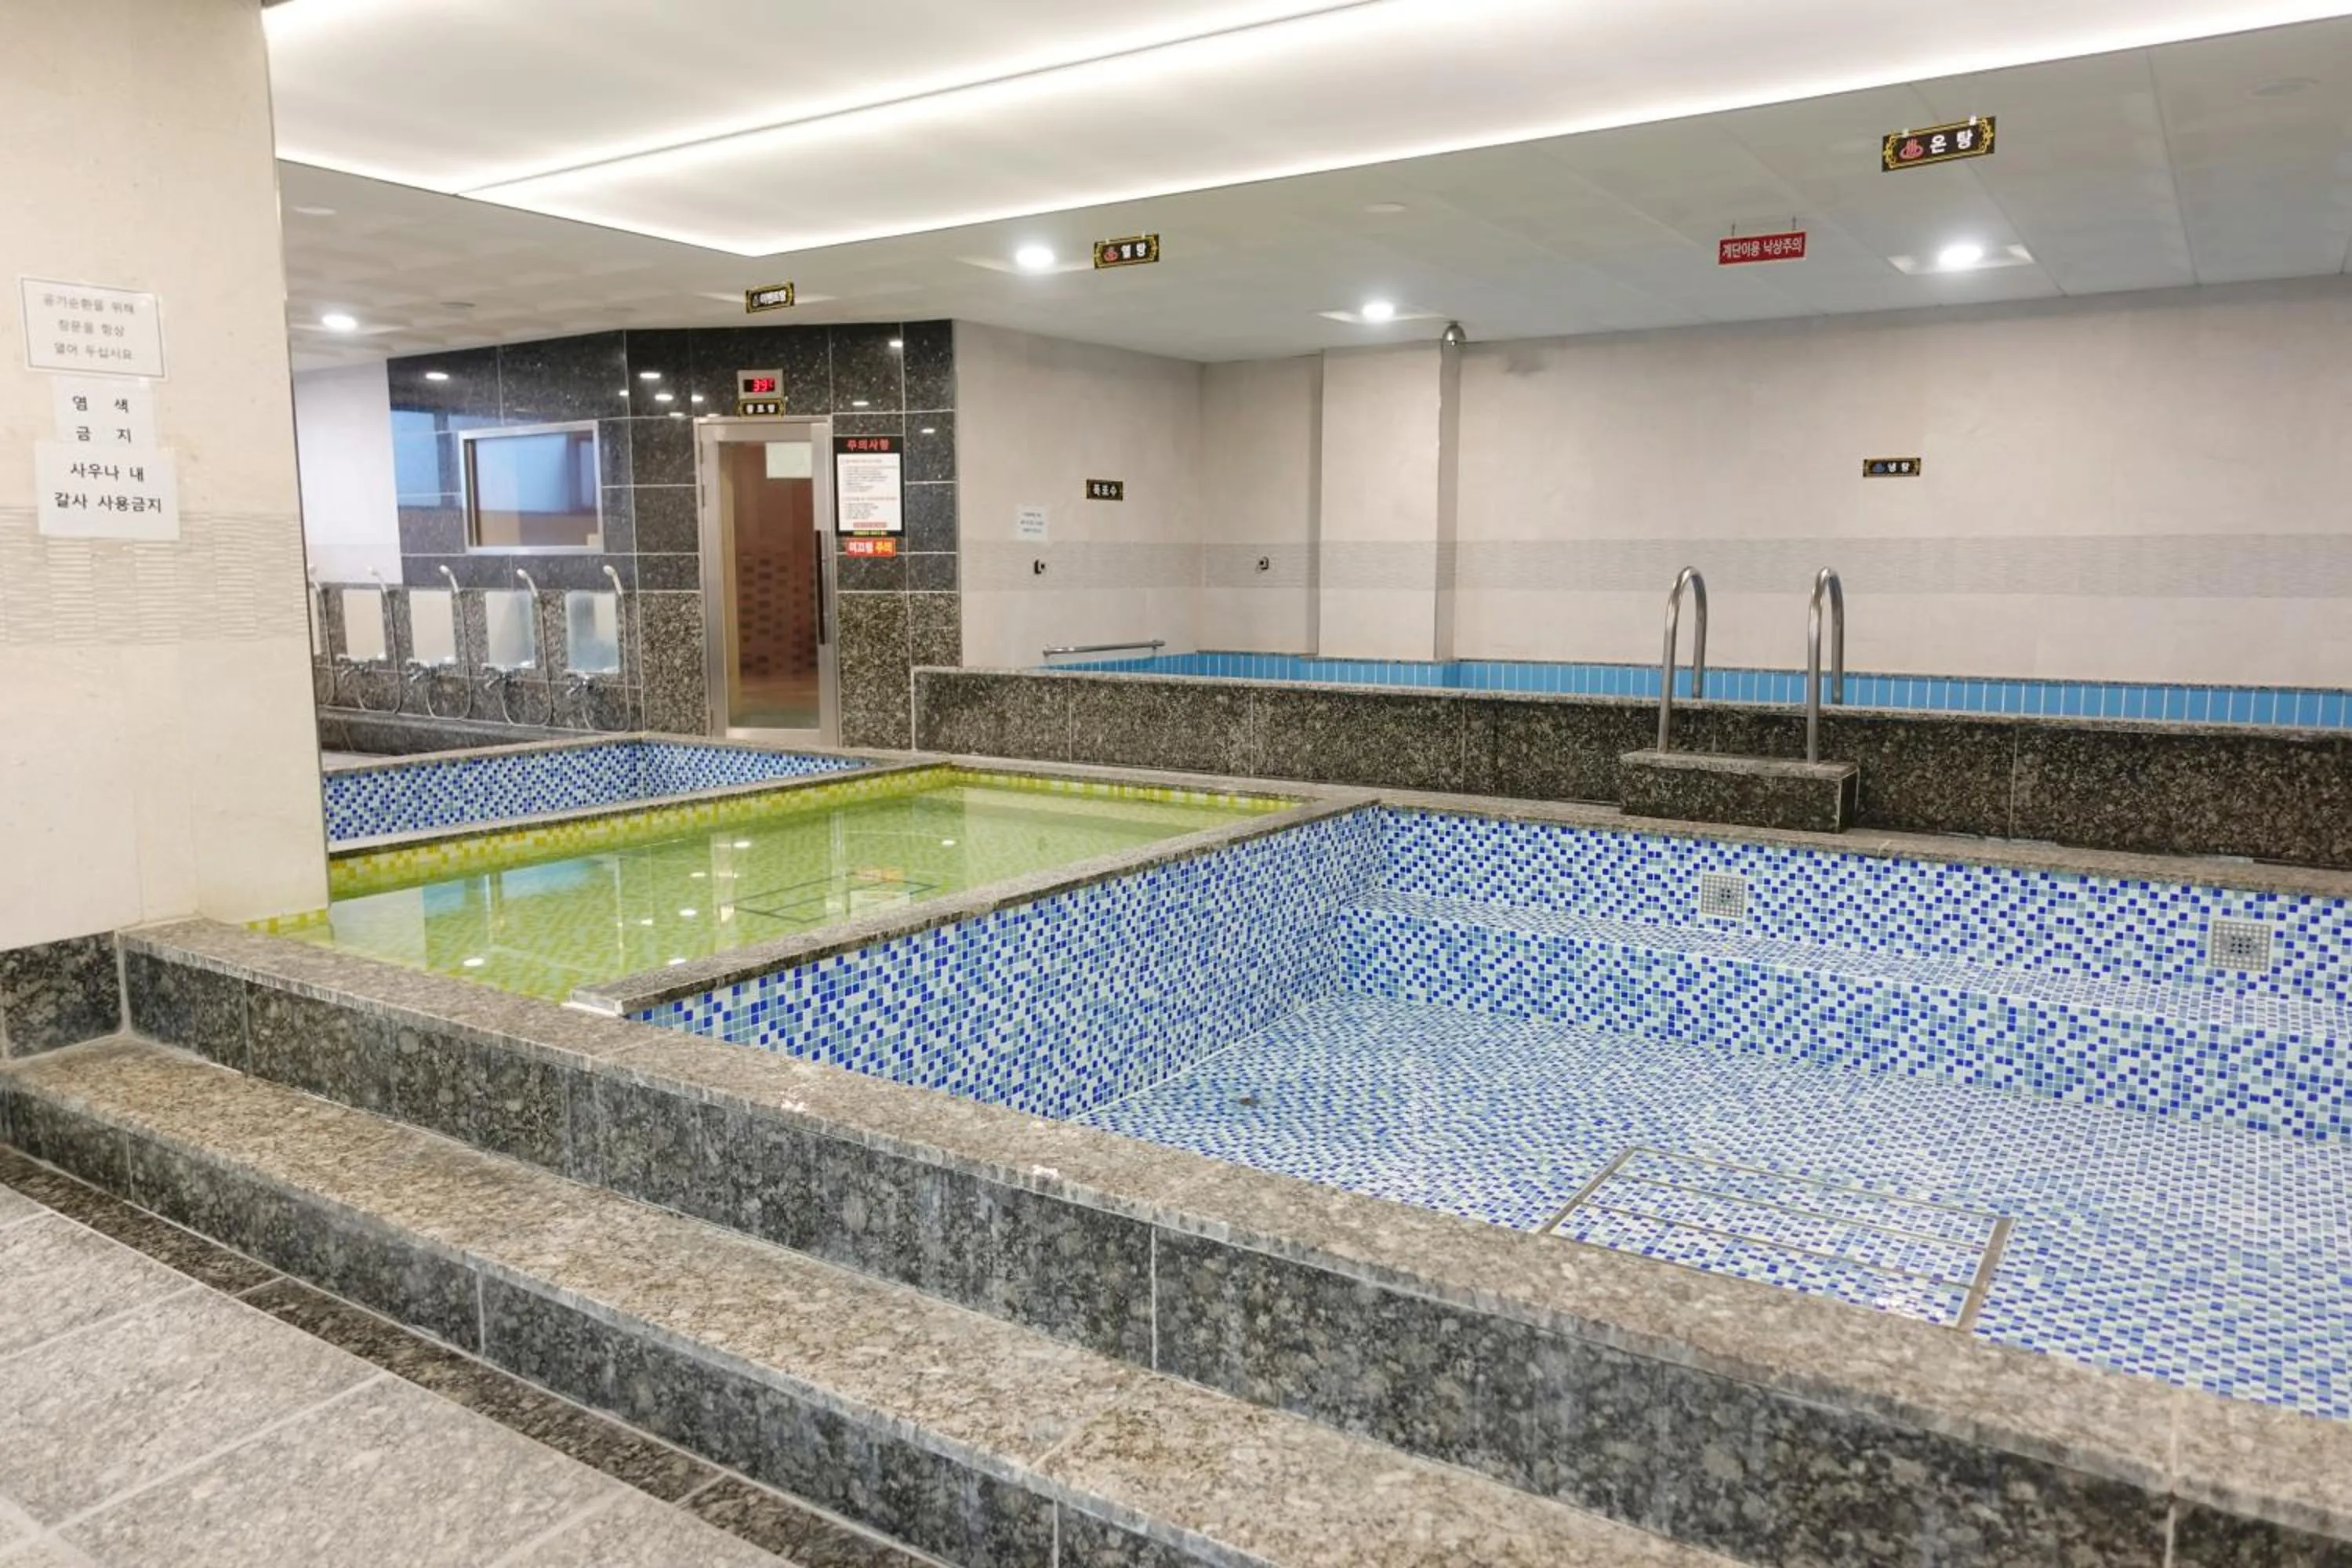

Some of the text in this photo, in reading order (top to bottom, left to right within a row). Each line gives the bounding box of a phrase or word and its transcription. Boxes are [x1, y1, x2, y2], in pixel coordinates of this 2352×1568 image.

[1929, 129, 1973, 154] 온탕
[1722, 236, 1802, 258] 계단이용 낙상주의
[112, 301, 135, 314] 위해
[101, 323, 125, 337] 항상
[54, 342, 78, 356] 열어
[70, 462, 144, 482] 사우나 내
[97, 494, 162, 514] 사용금지
